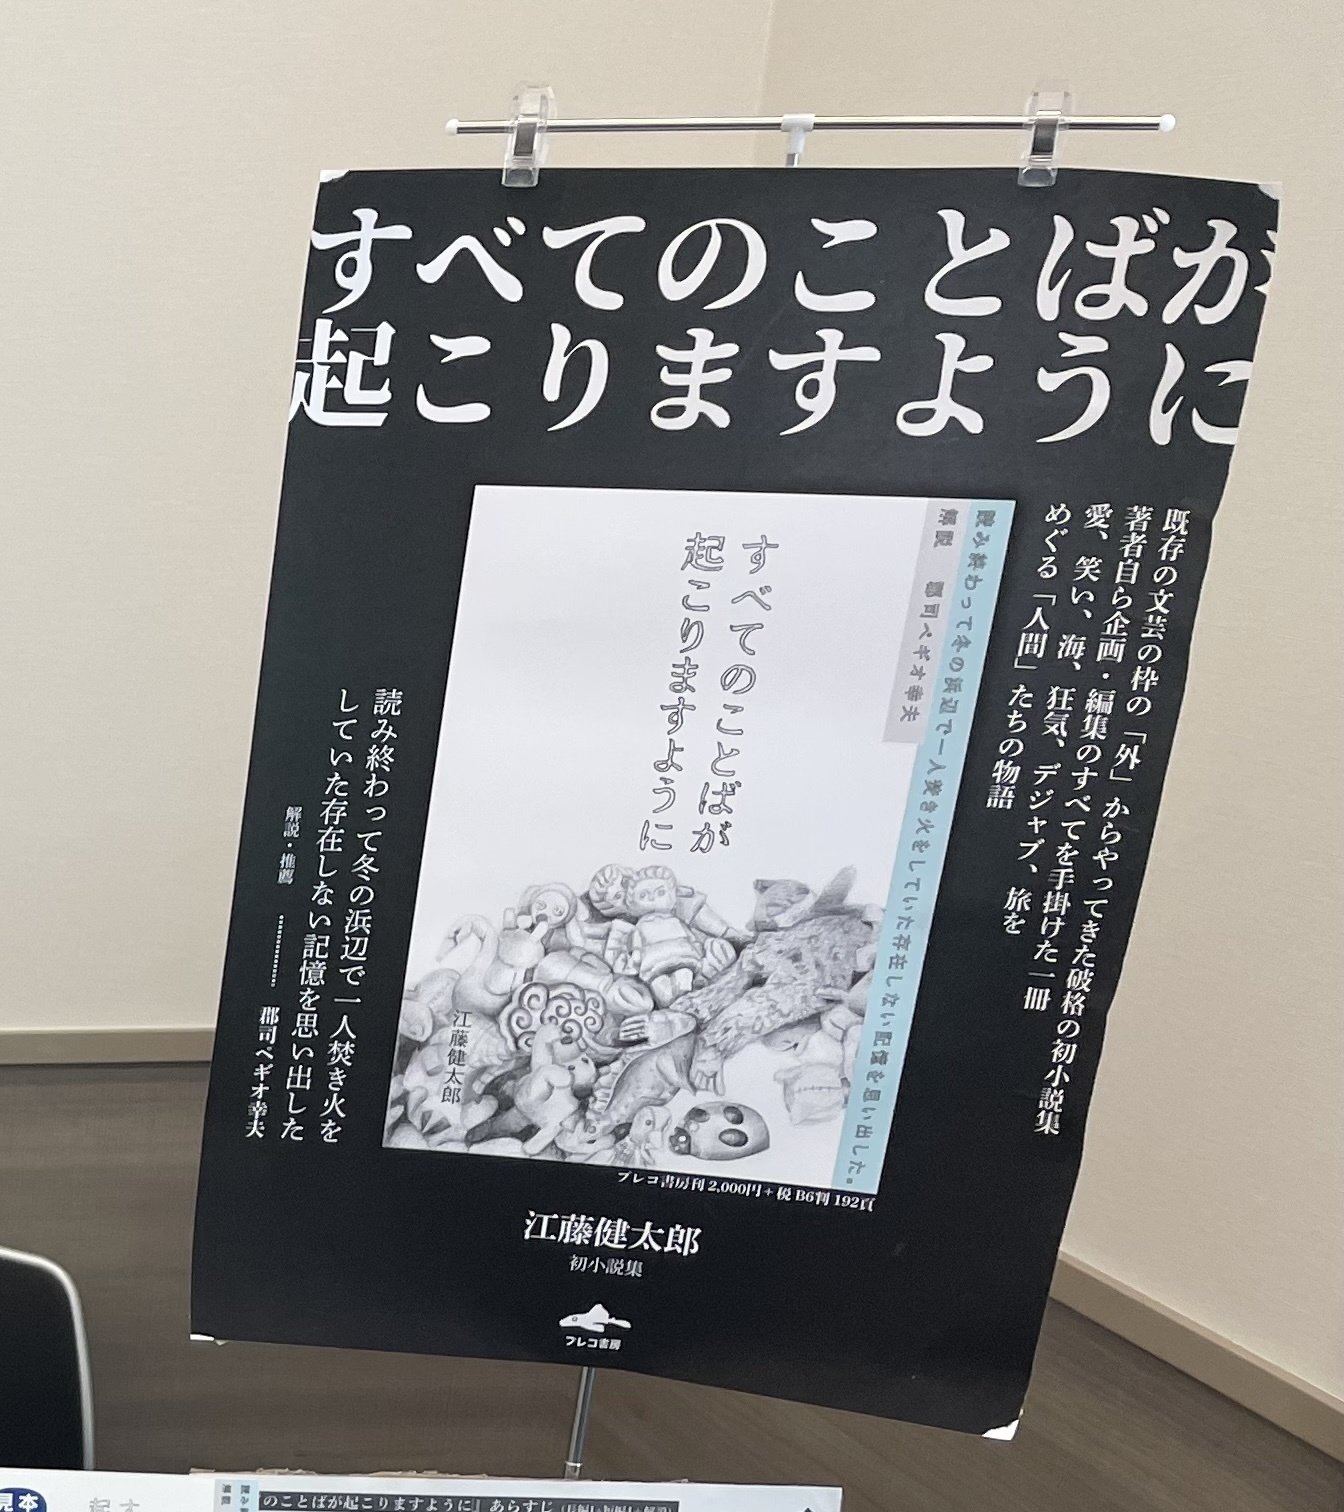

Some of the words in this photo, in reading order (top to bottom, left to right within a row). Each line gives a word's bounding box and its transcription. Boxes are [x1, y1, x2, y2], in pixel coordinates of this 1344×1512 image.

[291, 318, 1254, 446] 起こりますように
[311, 206, 1278, 325] すべてのことばが
[639, 532, 726, 851] 起こりますように
[691, 535, 780, 854] すべてのことばが
[986, 504, 1072, 810] めぐる「人間」たちの物語
[1024, 505, 1154, 1011] 著者自ら企画・編集のすべてを手掛けた一冊
[281, 688, 359, 1141] していた存在しない記憶を思い出した
[320, 688, 403, 1143] 読み終わって冬の浜辺で一人焚き火を
[1034, 508, 1191, 1136] 既存の文芸の枠の「外」からやってきた破格の初小説集
[246, 1006, 280, 1138] 郡司ペギオ幸夫
[440, 1010, 472, 1104] 江藤健太郎
[524, 1210, 702, 1257] 江藤健太郎
[568, 1254, 644, 1278] 初小説集
